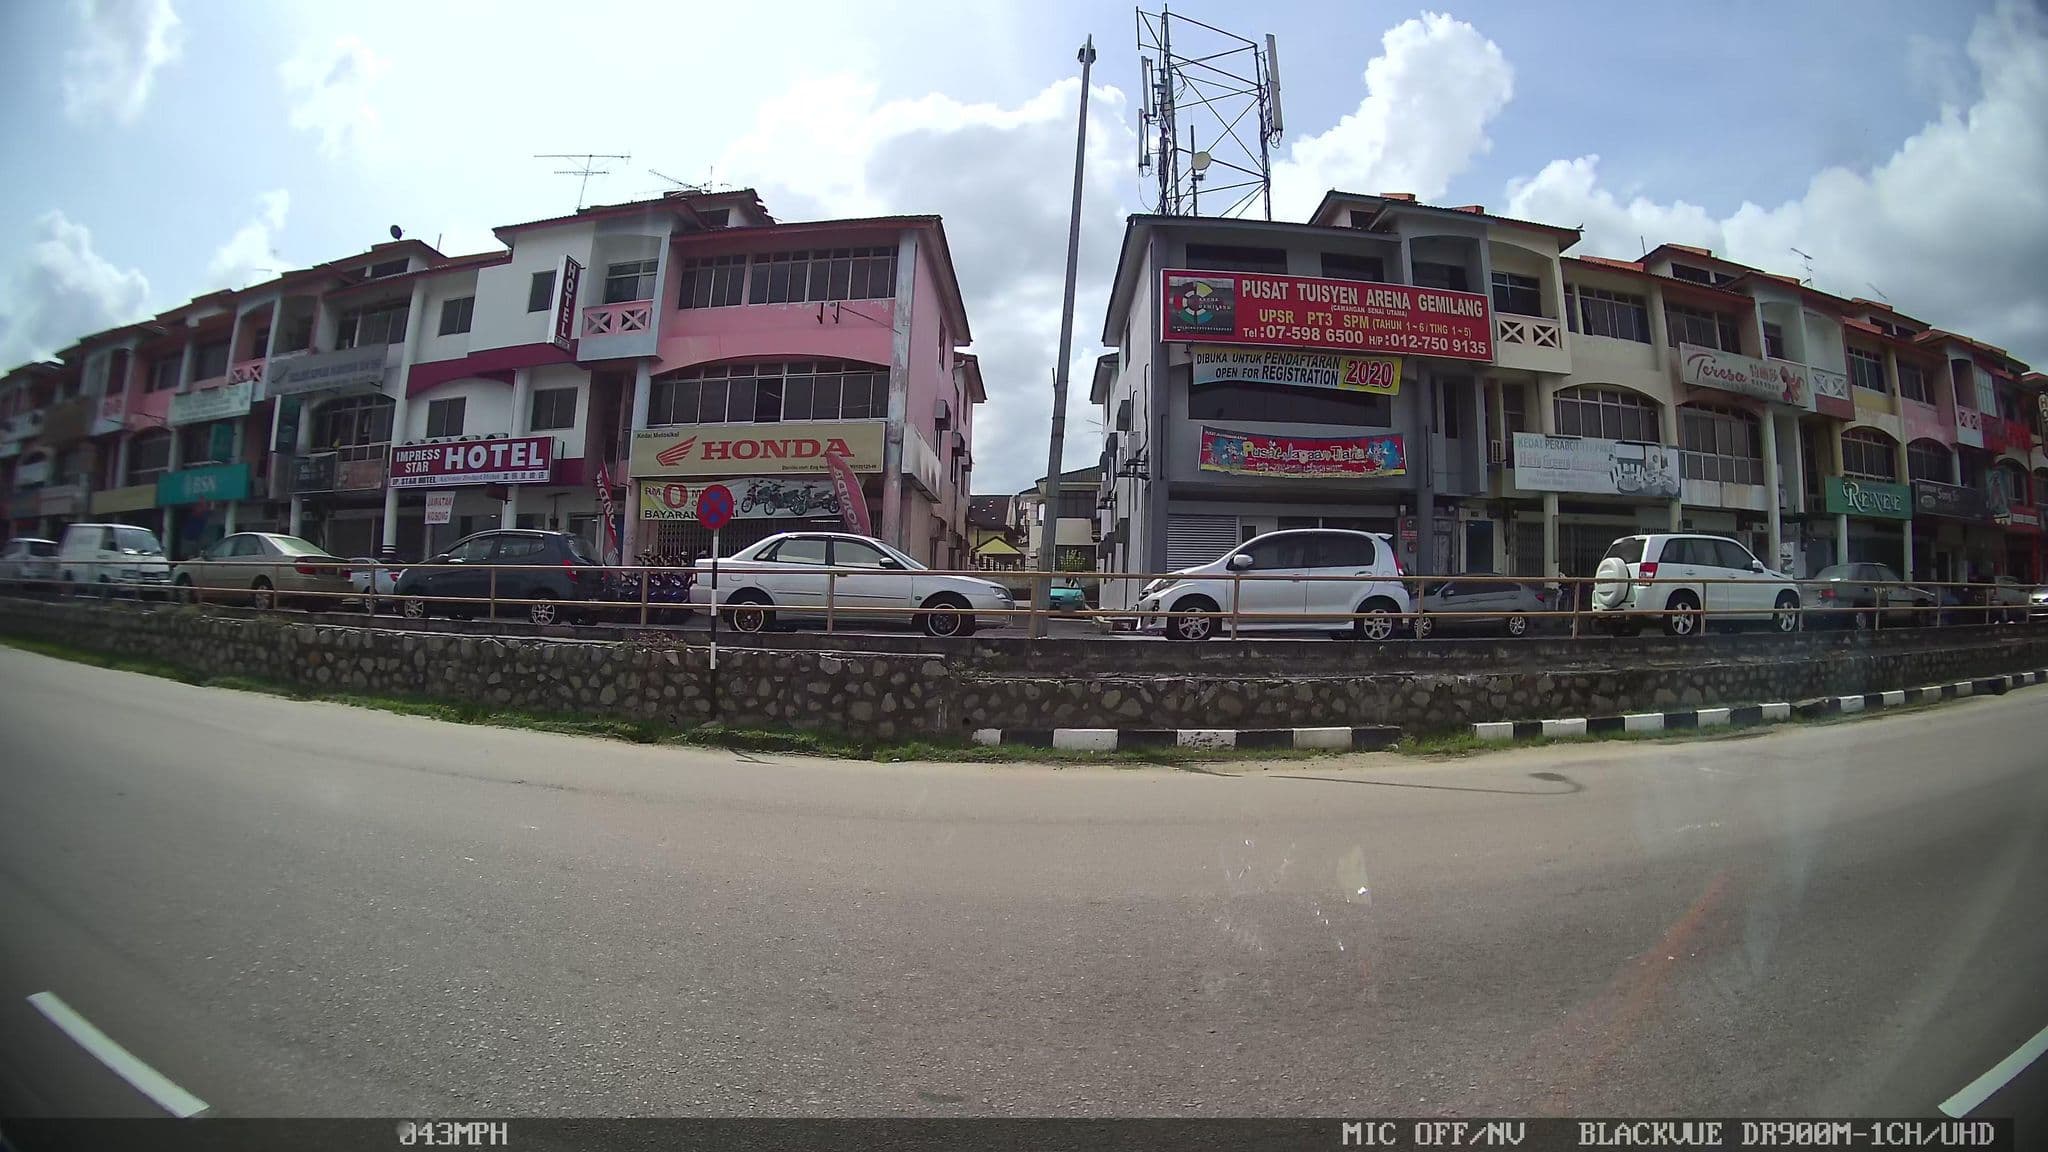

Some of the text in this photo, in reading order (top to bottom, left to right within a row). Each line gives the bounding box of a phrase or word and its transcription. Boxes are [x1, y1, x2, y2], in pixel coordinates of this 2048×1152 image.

[561, 262, 577, 338] HOTEL
[1242, 279, 1483, 318] PUSAT TUISYEN ARENA GEMILANG
[1259, 308, 1295, 324] UPSR
[1307, 311, 1333, 326] PT3
[1343, 314, 1370, 329] SPM
[1372, 319, 1402, 330] (TAHUN
[1325, 329, 1364, 344] 6500
[1452, 339, 1487, 355] 9135
[1196, 351, 1342, 370] DIBUKA UNTUK PENDAFTARAN
[1687, 353, 1746, 382] Teresa
[1215, 365, 1339, 386] OPEN FOR REGISTRATION
[1343, 359, 1395, 388] 2020
[396, 441, 544, 470] IMPRESS HOTEL
[700, 438, 855, 460] HONDA
[1242, 441, 1282, 459] Pusat
[1545, 439, 1579, 452] PERABOT
[405, 461, 429, 473] STAR
[645, 487, 661, 496] RM
[663, 484, 689, 508] 0
